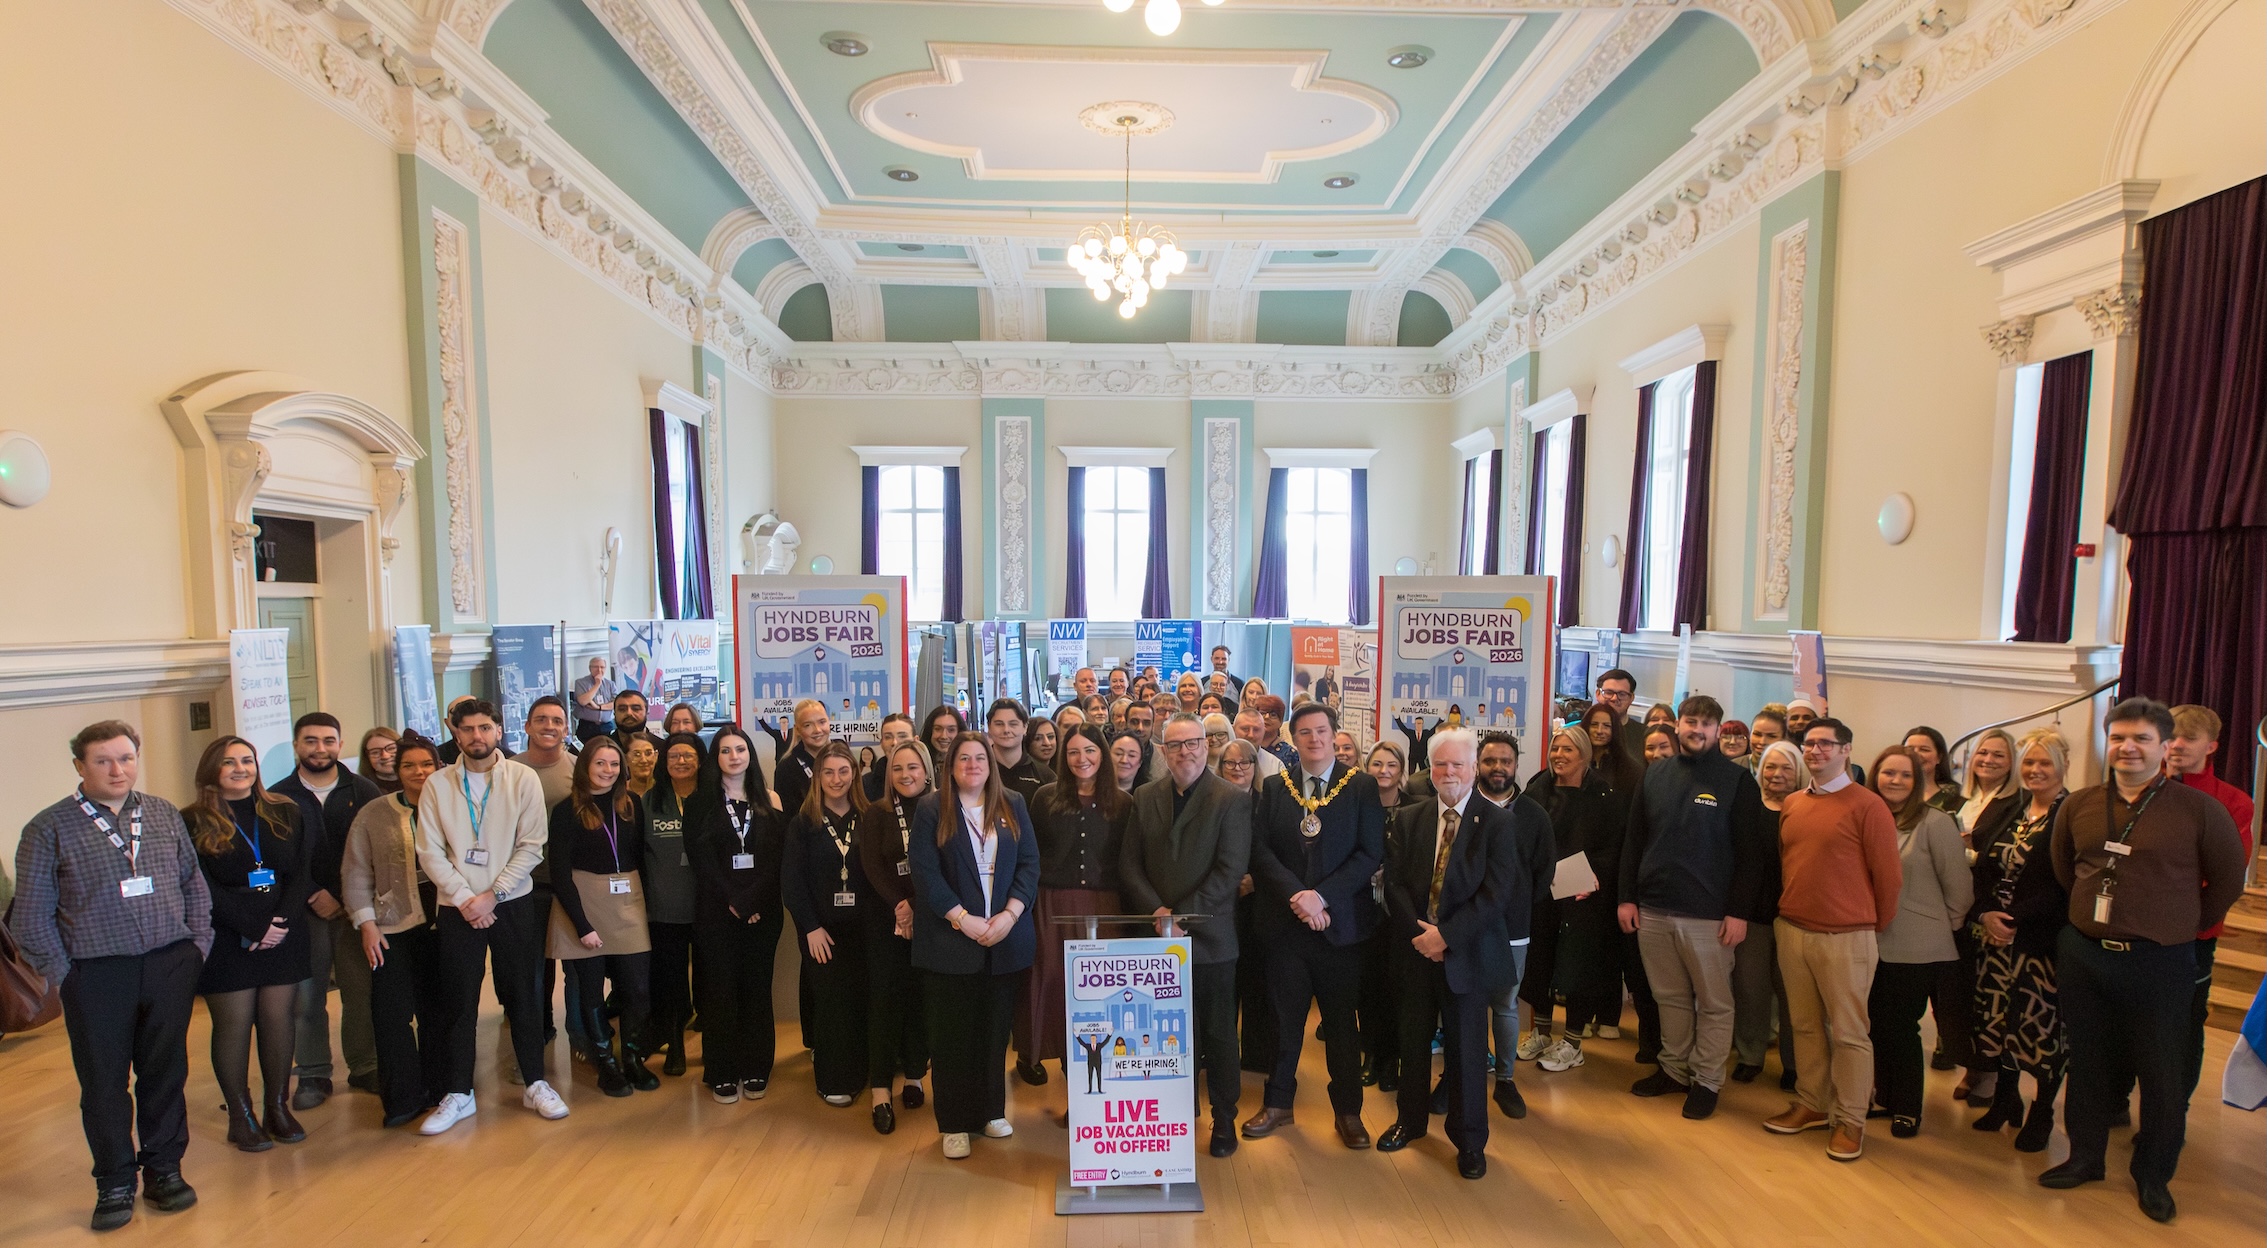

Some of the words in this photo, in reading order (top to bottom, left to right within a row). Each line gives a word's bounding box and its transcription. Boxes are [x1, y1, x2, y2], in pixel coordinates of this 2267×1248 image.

[764, 610, 870, 624] HYNDBURN
[1408, 613, 1512, 627] HYNDBURN
[762, 627, 819, 642] JOBS
[825, 626, 874, 641] FAIR
[1052, 623, 1083, 639] NW
[1404, 629, 1459, 644] JOBS
[1465, 630, 1515, 646] FAIR
[689, 634, 711, 649] Vital
[852, 645, 882, 657] 2026
[1491, 650, 1522, 662] 2026
[1400, 707, 1439, 715] AVAILABLE!
[843, 722, 878, 733] HIRING!
[1080, 958, 1173, 972] HYNDBURN
[1078, 973, 1128, 988] JOBS
[1133, 972, 1175, 986] FAIR
[1156, 988, 1180, 998] 2026
[1145, 1058, 1178, 1069] HIRING!
[1104, 1099, 1159, 1123] LIVE
[1075, 1126, 1103, 1143] JOB
[1105, 1123, 1188, 1138] VACANCIES
[1093, 1141, 1117, 1154] ON
[1120, 1139, 1171, 1153] OFFER!
[1074, 1171, 1087, 1180] FREE
[1088, 1170, 1106, 1179] ENTRY
